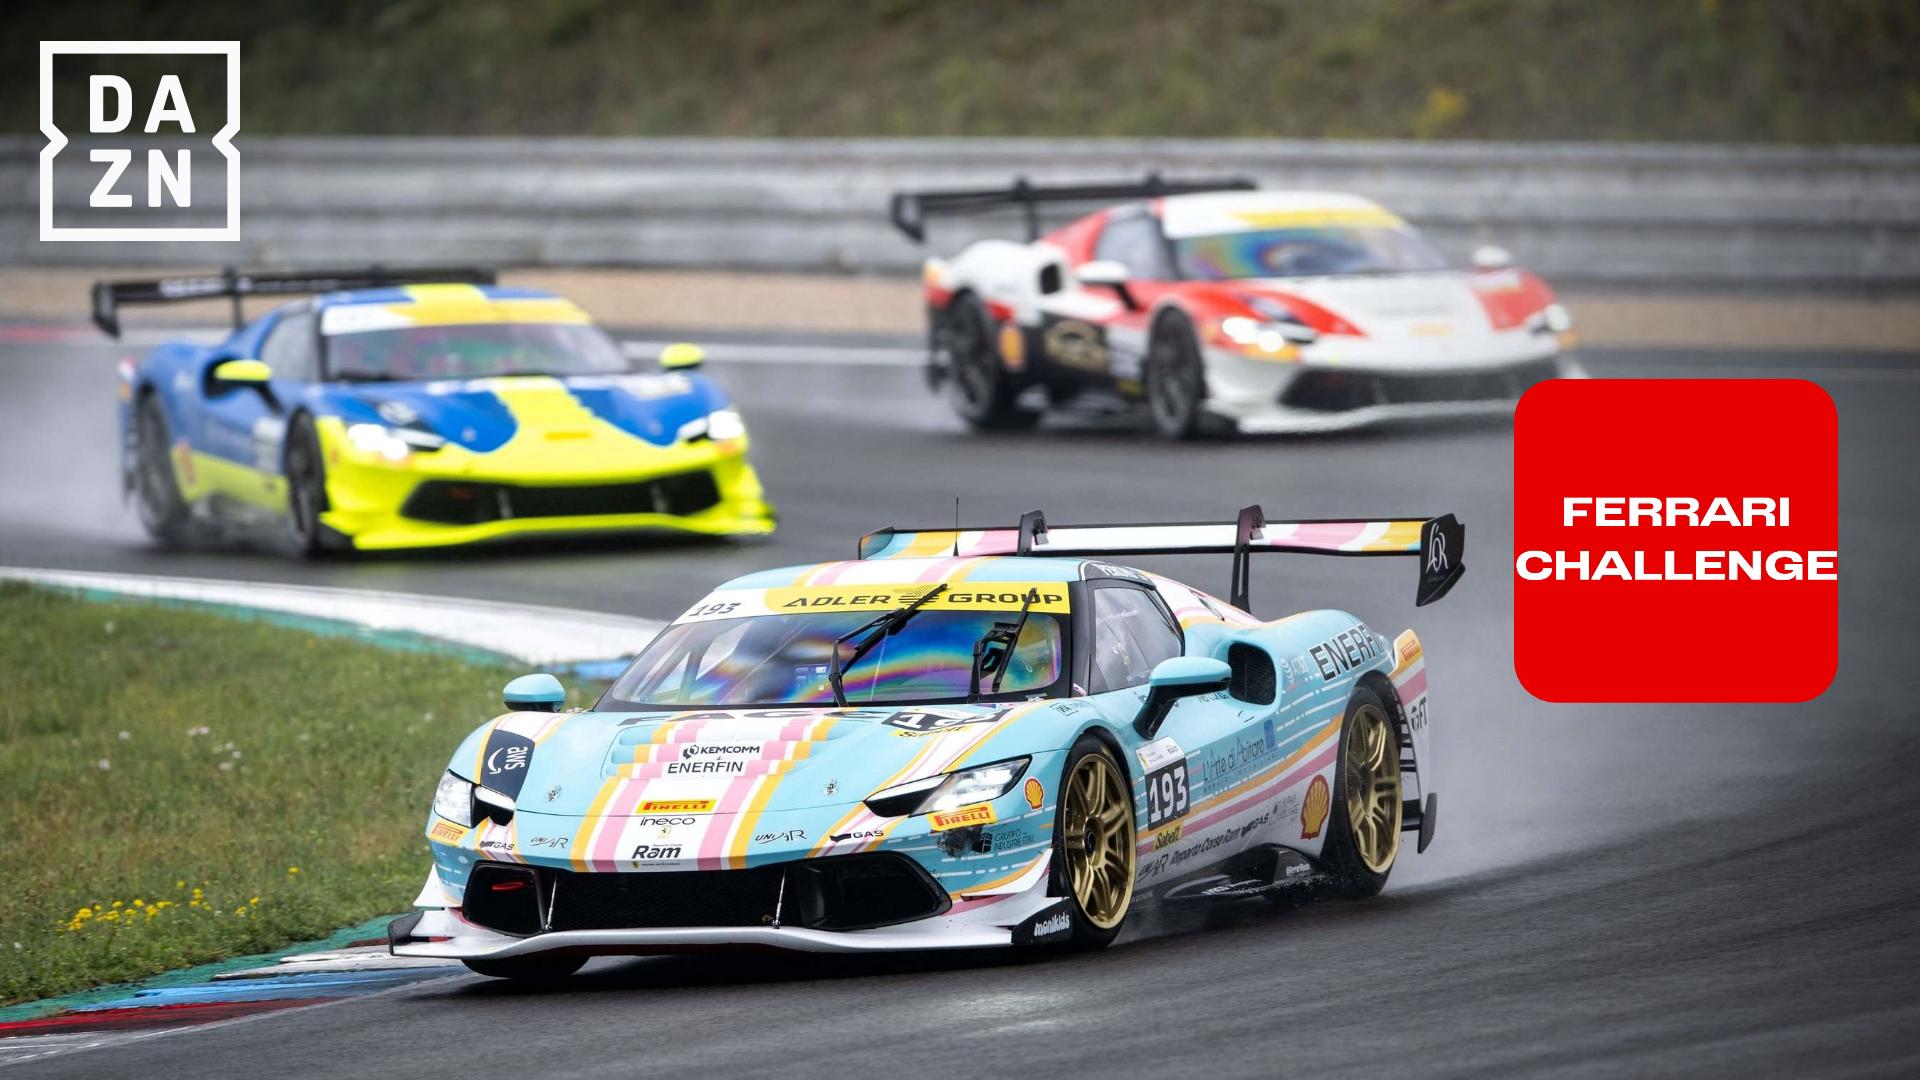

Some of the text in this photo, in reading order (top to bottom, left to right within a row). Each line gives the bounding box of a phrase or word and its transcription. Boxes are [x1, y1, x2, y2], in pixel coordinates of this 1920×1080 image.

[781, 593, 1063, 608] ADLER GROUP
[688, 602, 742, 617] 193
[700, 746, 760, 754] KEMCOMM
[667, 761, 744, 774] ENERFIN
[1149, 765, 1187, 823] 193
[643, 800, 710, 811] PIRELLI
[640, 816, 696, 826] ineco
[934, 806, 991, 827] PIRELLI
[432, 822, 464, 841] PIRELLI
[853, 830, 885, 838] GAS
[1155, 824, 1181, 850] Sabelt
[493, 842, 515, 850] GAS
[631, 845, 682, 859] Ram
